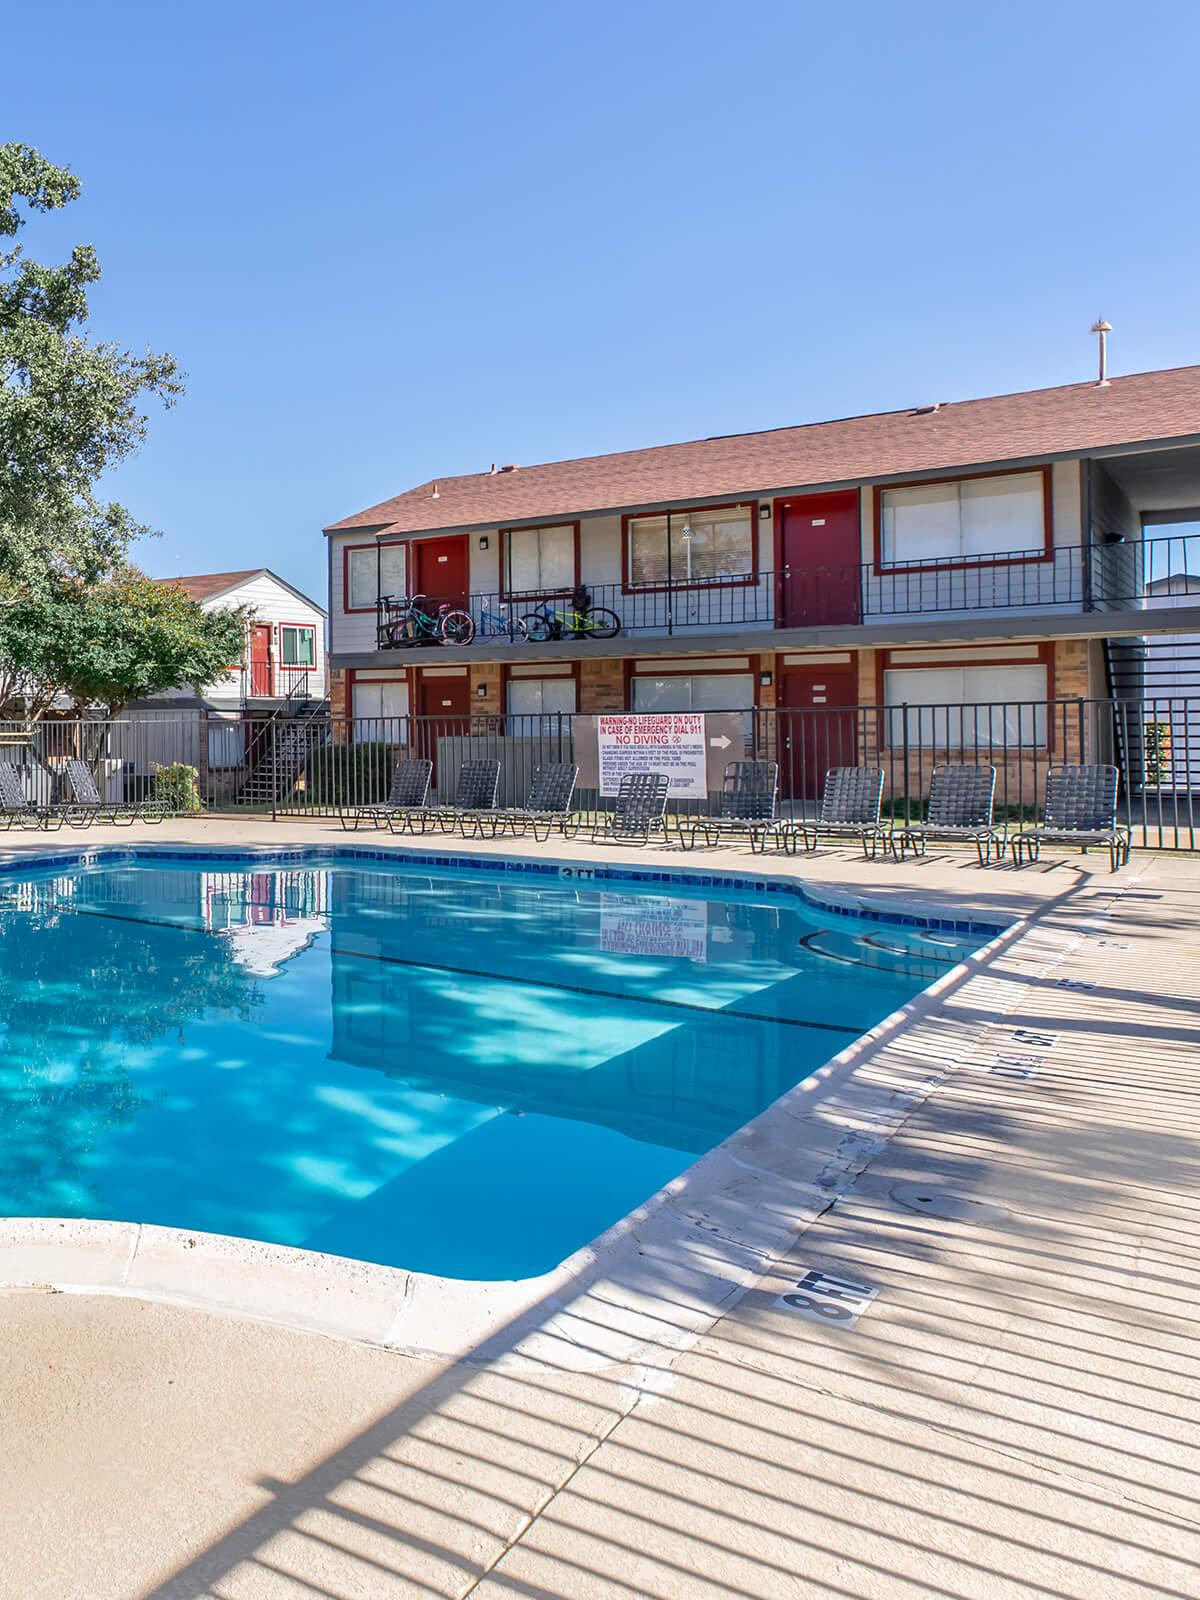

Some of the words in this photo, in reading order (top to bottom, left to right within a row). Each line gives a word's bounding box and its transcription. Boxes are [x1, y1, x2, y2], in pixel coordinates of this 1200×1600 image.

[639, 716, 672, 725] LIFEGUARD
[674, 716, 683, 724] ON
[684, 715, 701, 724] DUTY
[600, 726, 606, 734] IN
[608, 726, 623, 734] CASE
[625, 726, 633, 734] OF
[634, 725, 672, 734] EMERGENCY
[674, 725, 688, 734] DIAL
[690, 725, 701, 734] 911
[616, 735, 630, 744] NO
[634, 735, 669, 744] DIVING
[783, 1294, 853, 1320] 8
